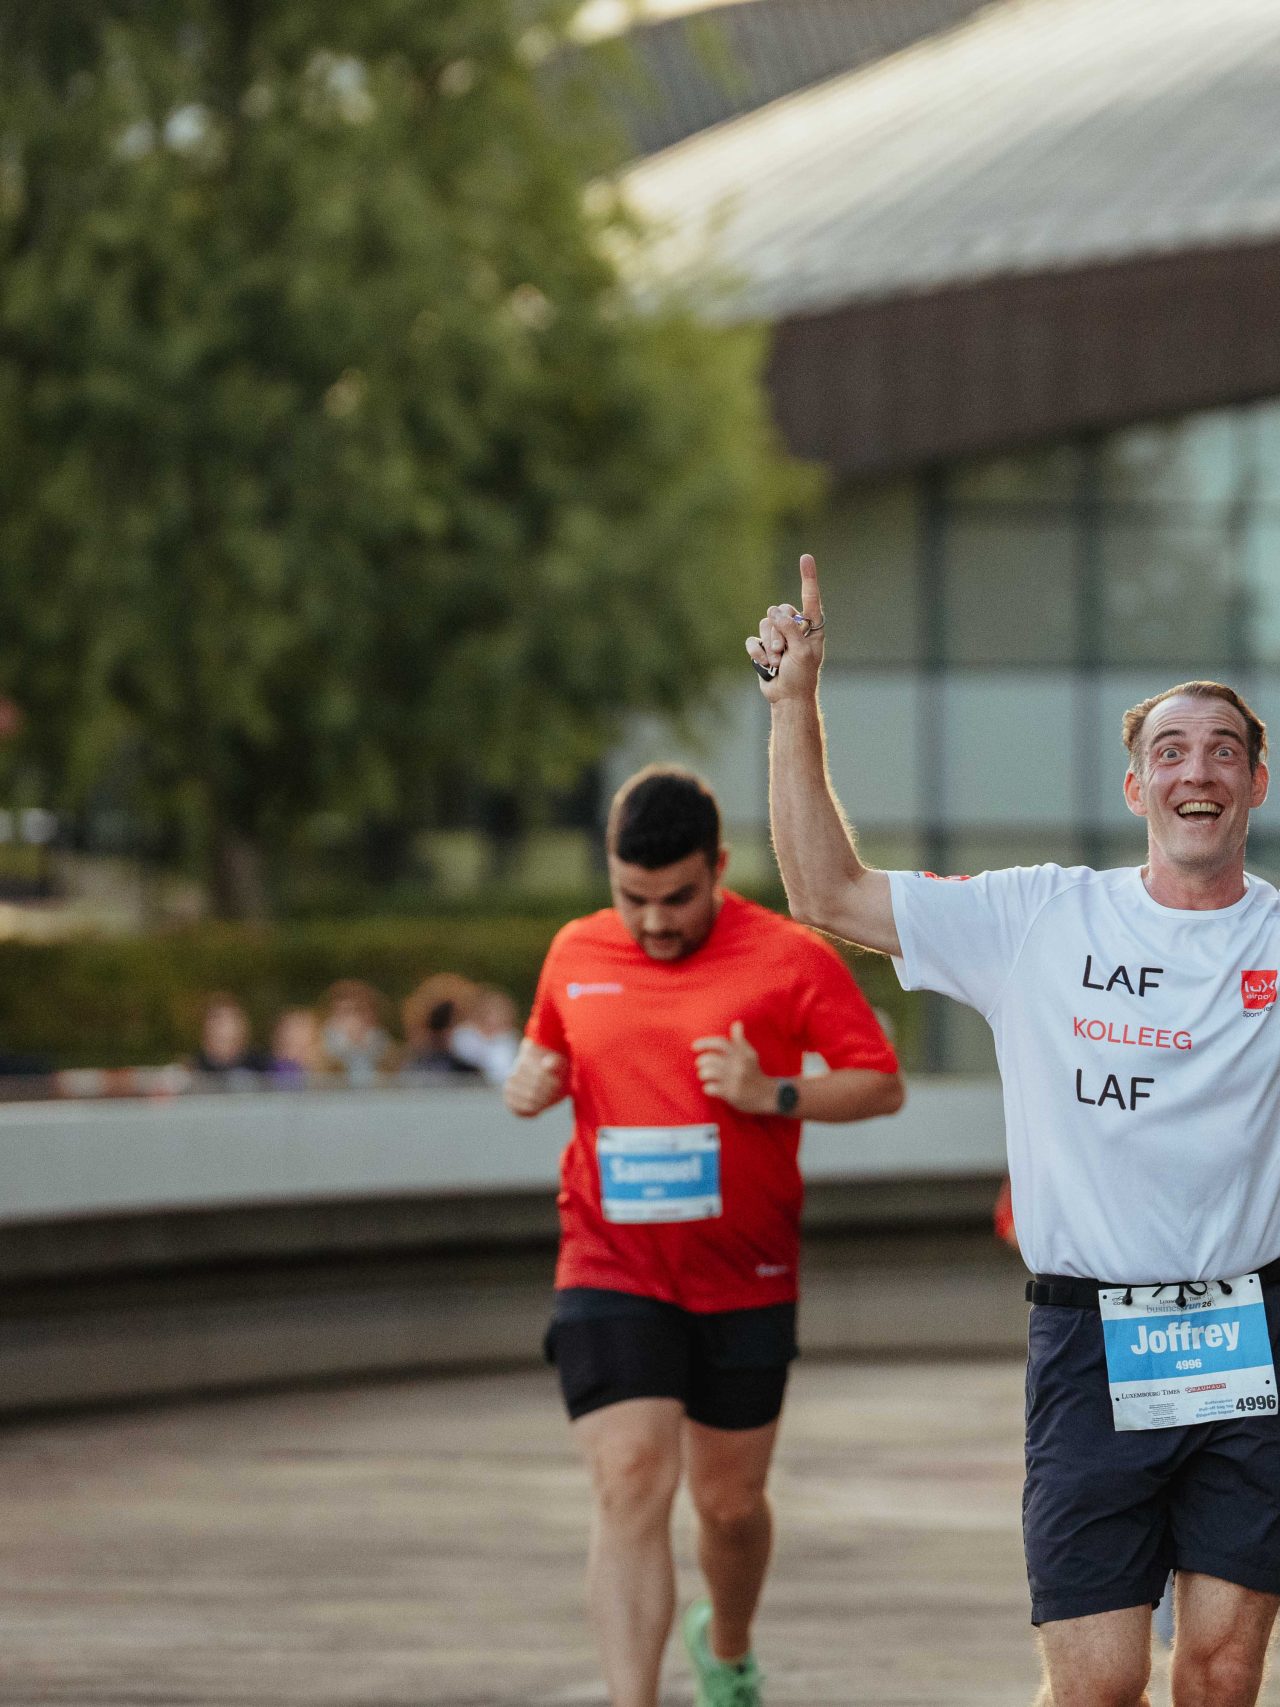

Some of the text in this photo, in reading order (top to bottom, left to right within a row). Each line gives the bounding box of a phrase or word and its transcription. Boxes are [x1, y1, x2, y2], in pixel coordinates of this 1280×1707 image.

[1082, 954, 1164, 997] LAF
[1073, 1016, 1192, 1050] KOLLEEG
[1075, 1068, 1155, 1111] LAF
[1201, 1300, 1212, 1308] 26
[1130, 1321, 1240, 1355] Joffrey
[1175, 1358, 1203, 1371] 4996
[1191, 1383, 1226, 1393] BAUHAUS
[1235, 1394, 1277, 1412] 4996
